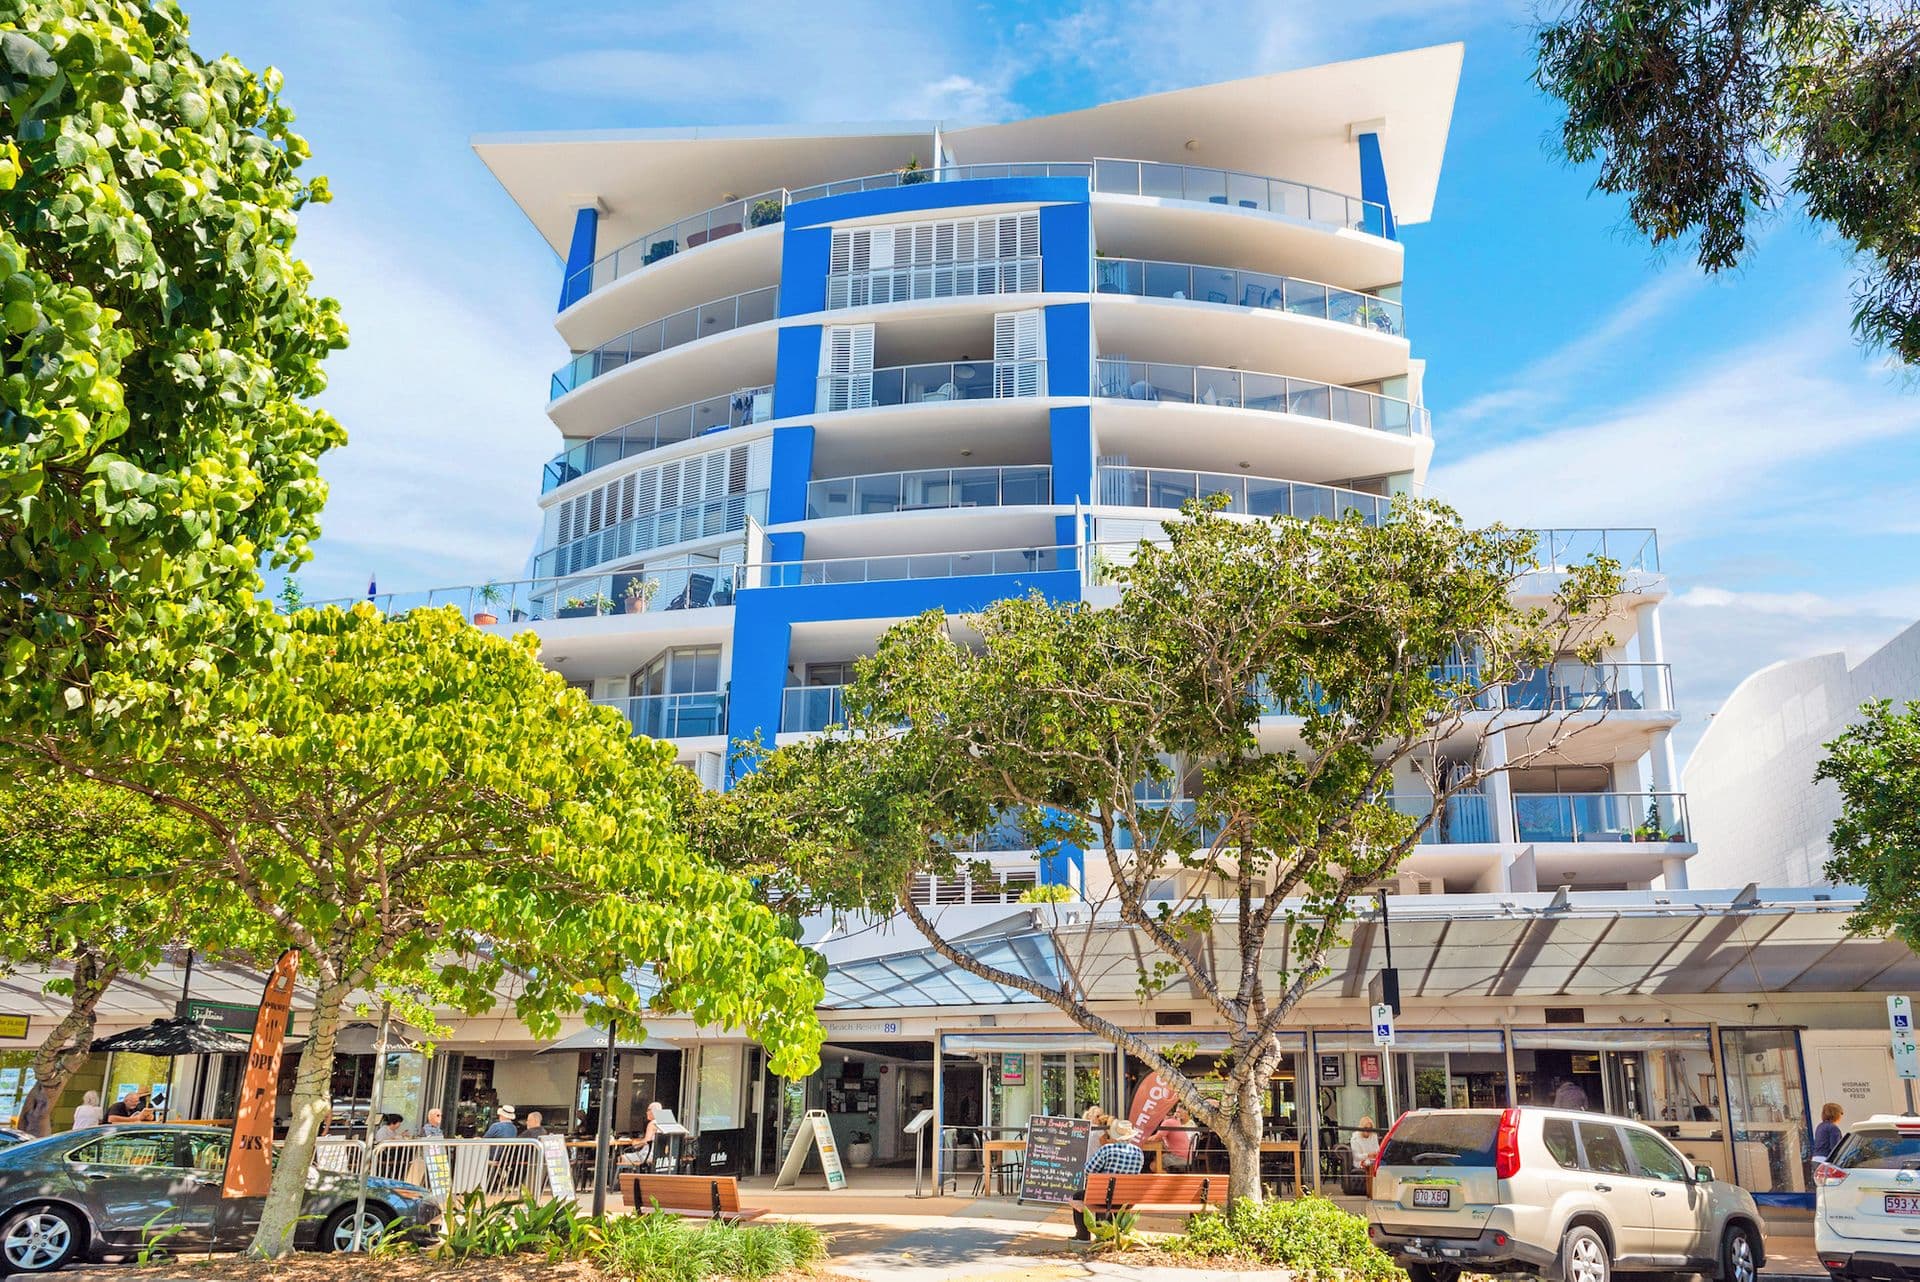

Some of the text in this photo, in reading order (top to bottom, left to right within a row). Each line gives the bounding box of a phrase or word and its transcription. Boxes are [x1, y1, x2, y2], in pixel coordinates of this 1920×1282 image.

[1894, 998, 1903, 1008] P
[1378, 1007, 1386, 1017] P
[884, 1023, 896, 1033] 89
